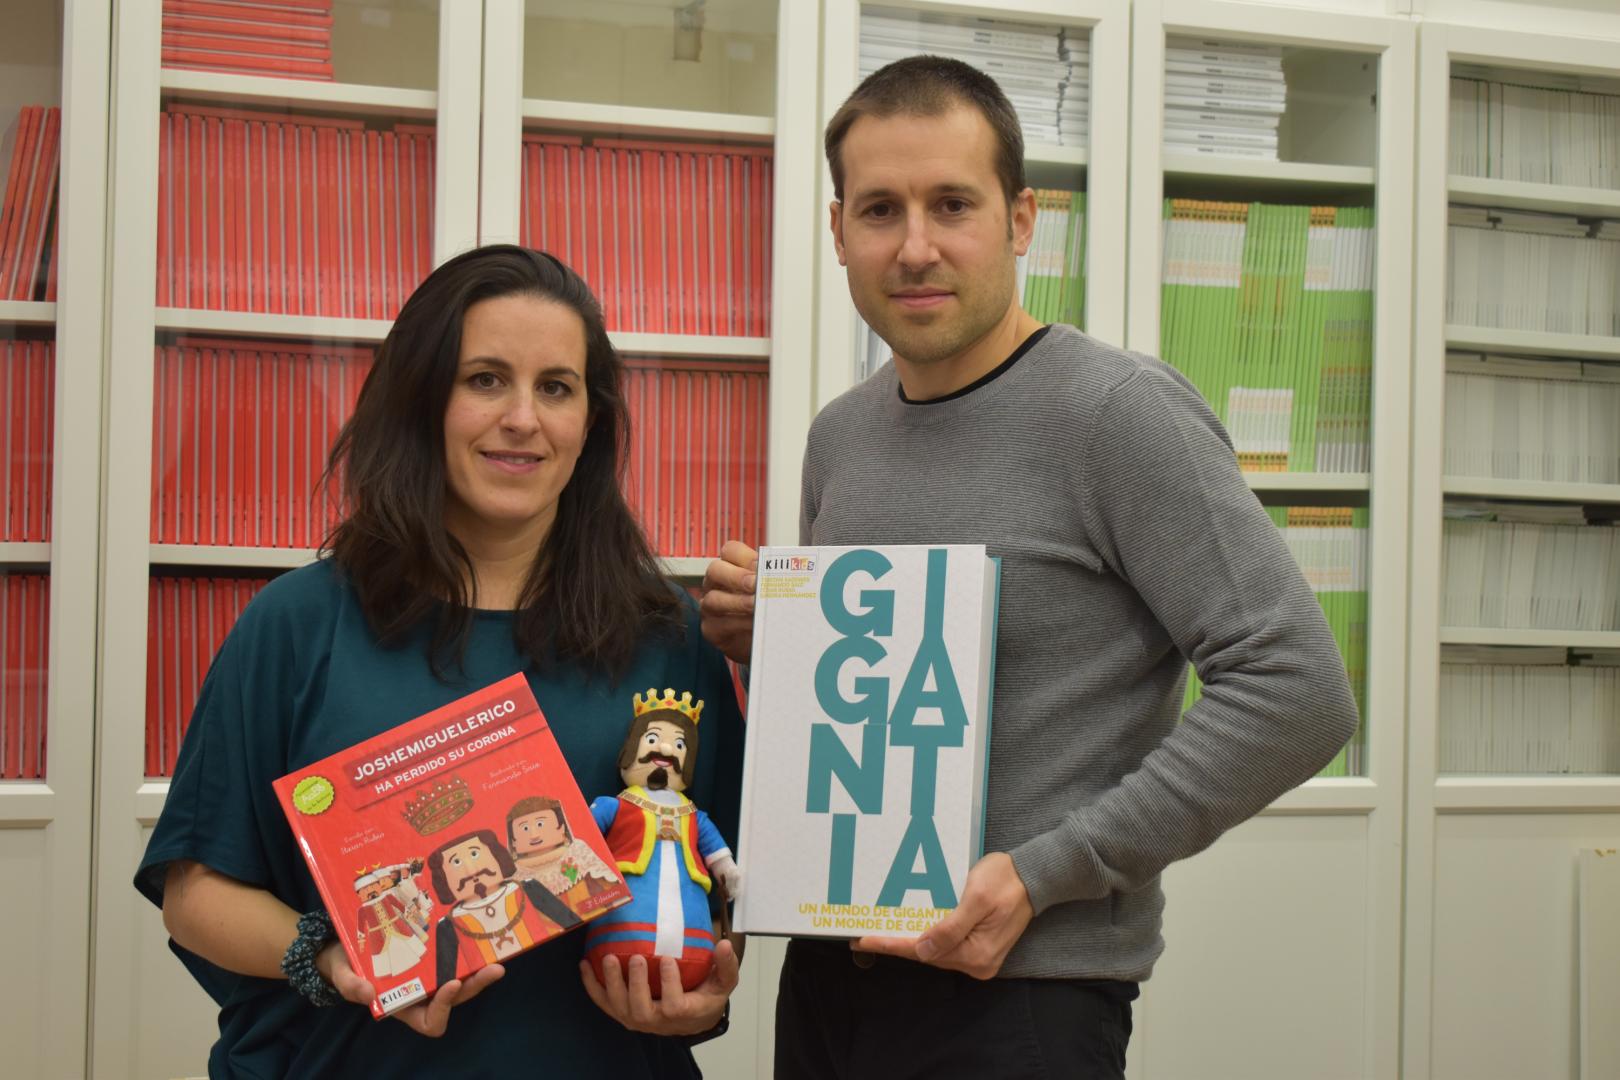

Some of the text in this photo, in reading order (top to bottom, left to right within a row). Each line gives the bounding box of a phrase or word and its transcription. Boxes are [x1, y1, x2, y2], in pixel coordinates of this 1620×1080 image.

[354, 700, 516, 781] JOSHEMIGUELERICO
[375, 725, 517, 794] HA PERDIDO SU CORONA
[799, 903, 817, 914] UN
[820, 904, 870, 917] MUNDO
[873, 906, 889, 918] DE
[813, 916, 832, 928] UN
[835, 917, 882, 930] MONDE
[886, 919, 903, 931] DE
